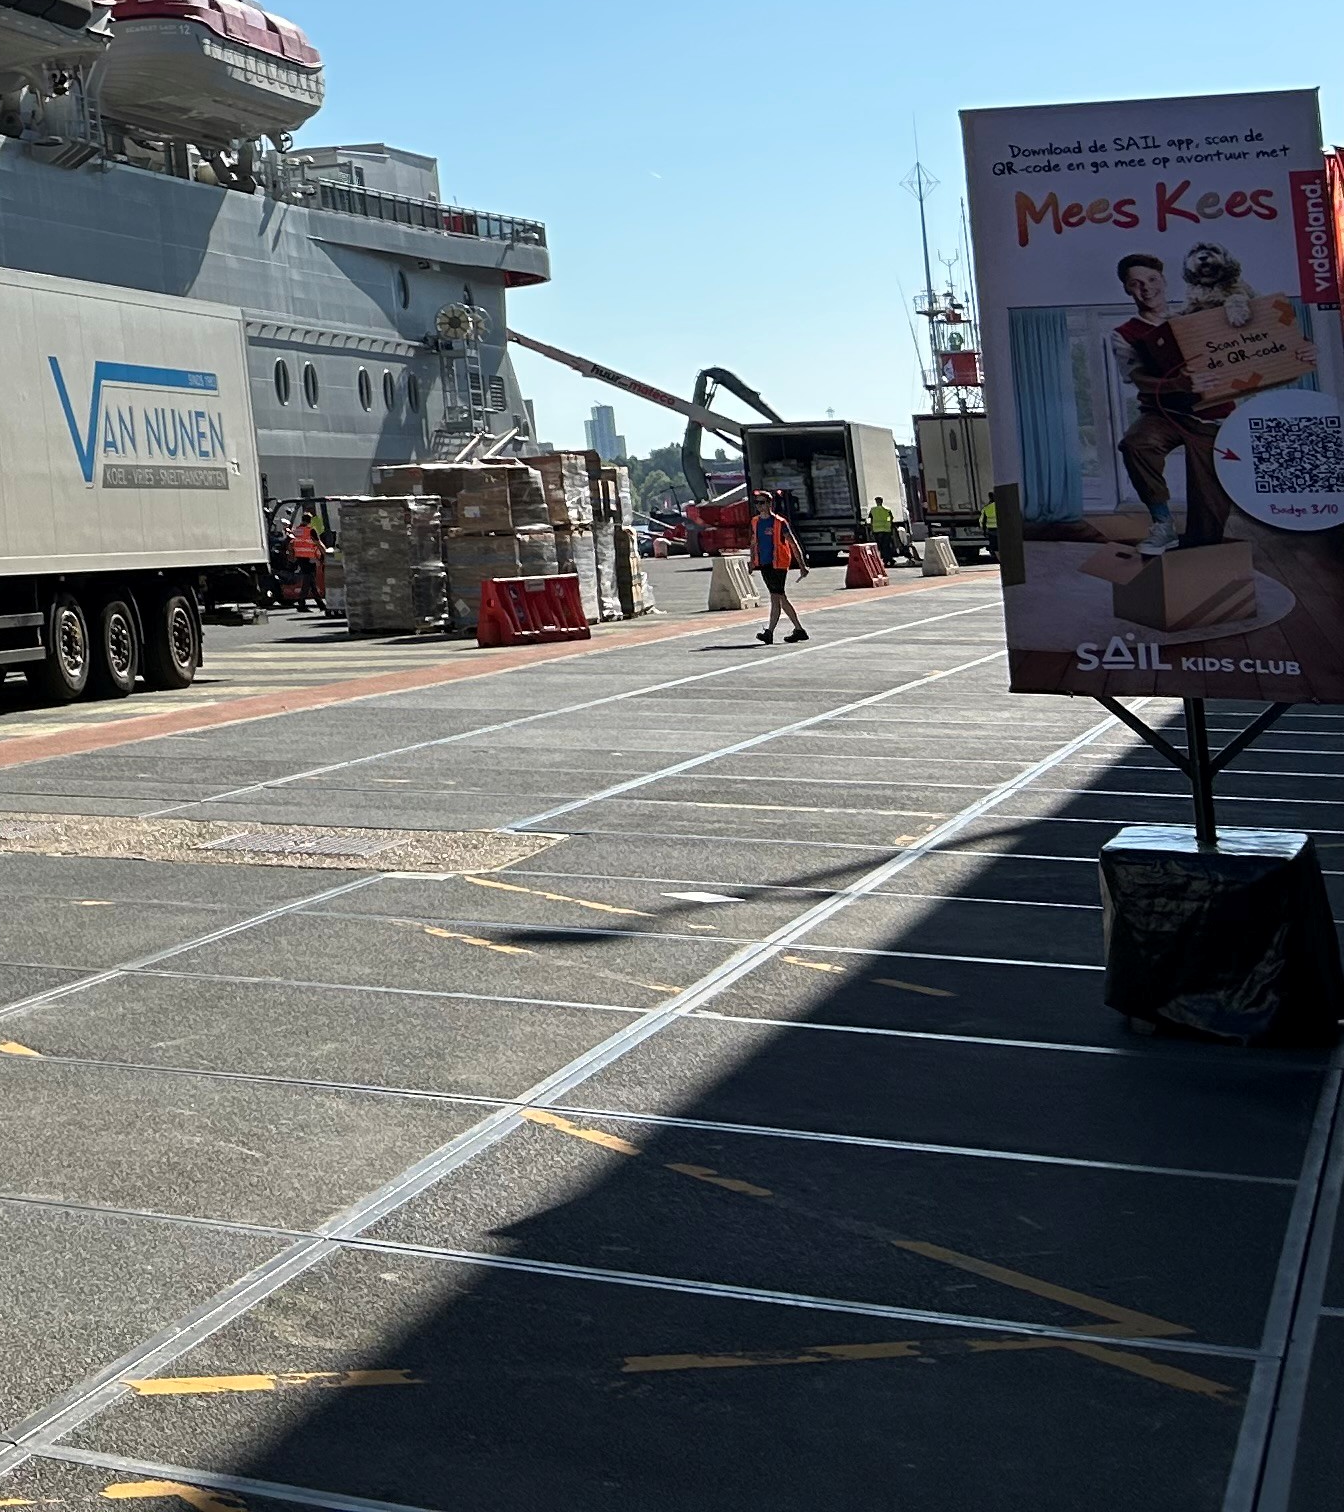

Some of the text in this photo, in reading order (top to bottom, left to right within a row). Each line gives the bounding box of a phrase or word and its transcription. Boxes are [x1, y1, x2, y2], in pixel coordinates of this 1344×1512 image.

[179, 24, 191, 35] 12
[1008, 128, 1265, 158] Download de SAIL app, scan de
[992, 144, 1290, 176] QR-code en ga mee op avontuur met
[1015, 179, 1278, 248] Mees Kees
[1205, 332, 1269, 354] Scan hier
[1207, 341, 1287, 369] de QR-code
[590, 364, 676, 405] huur mateco
[143, 406, 227, 459] NUNEN
[1269, 504, 1339, 517] Badge 3/10
[1076, 633, 1301, 676] SAIL KIDS CLUB
